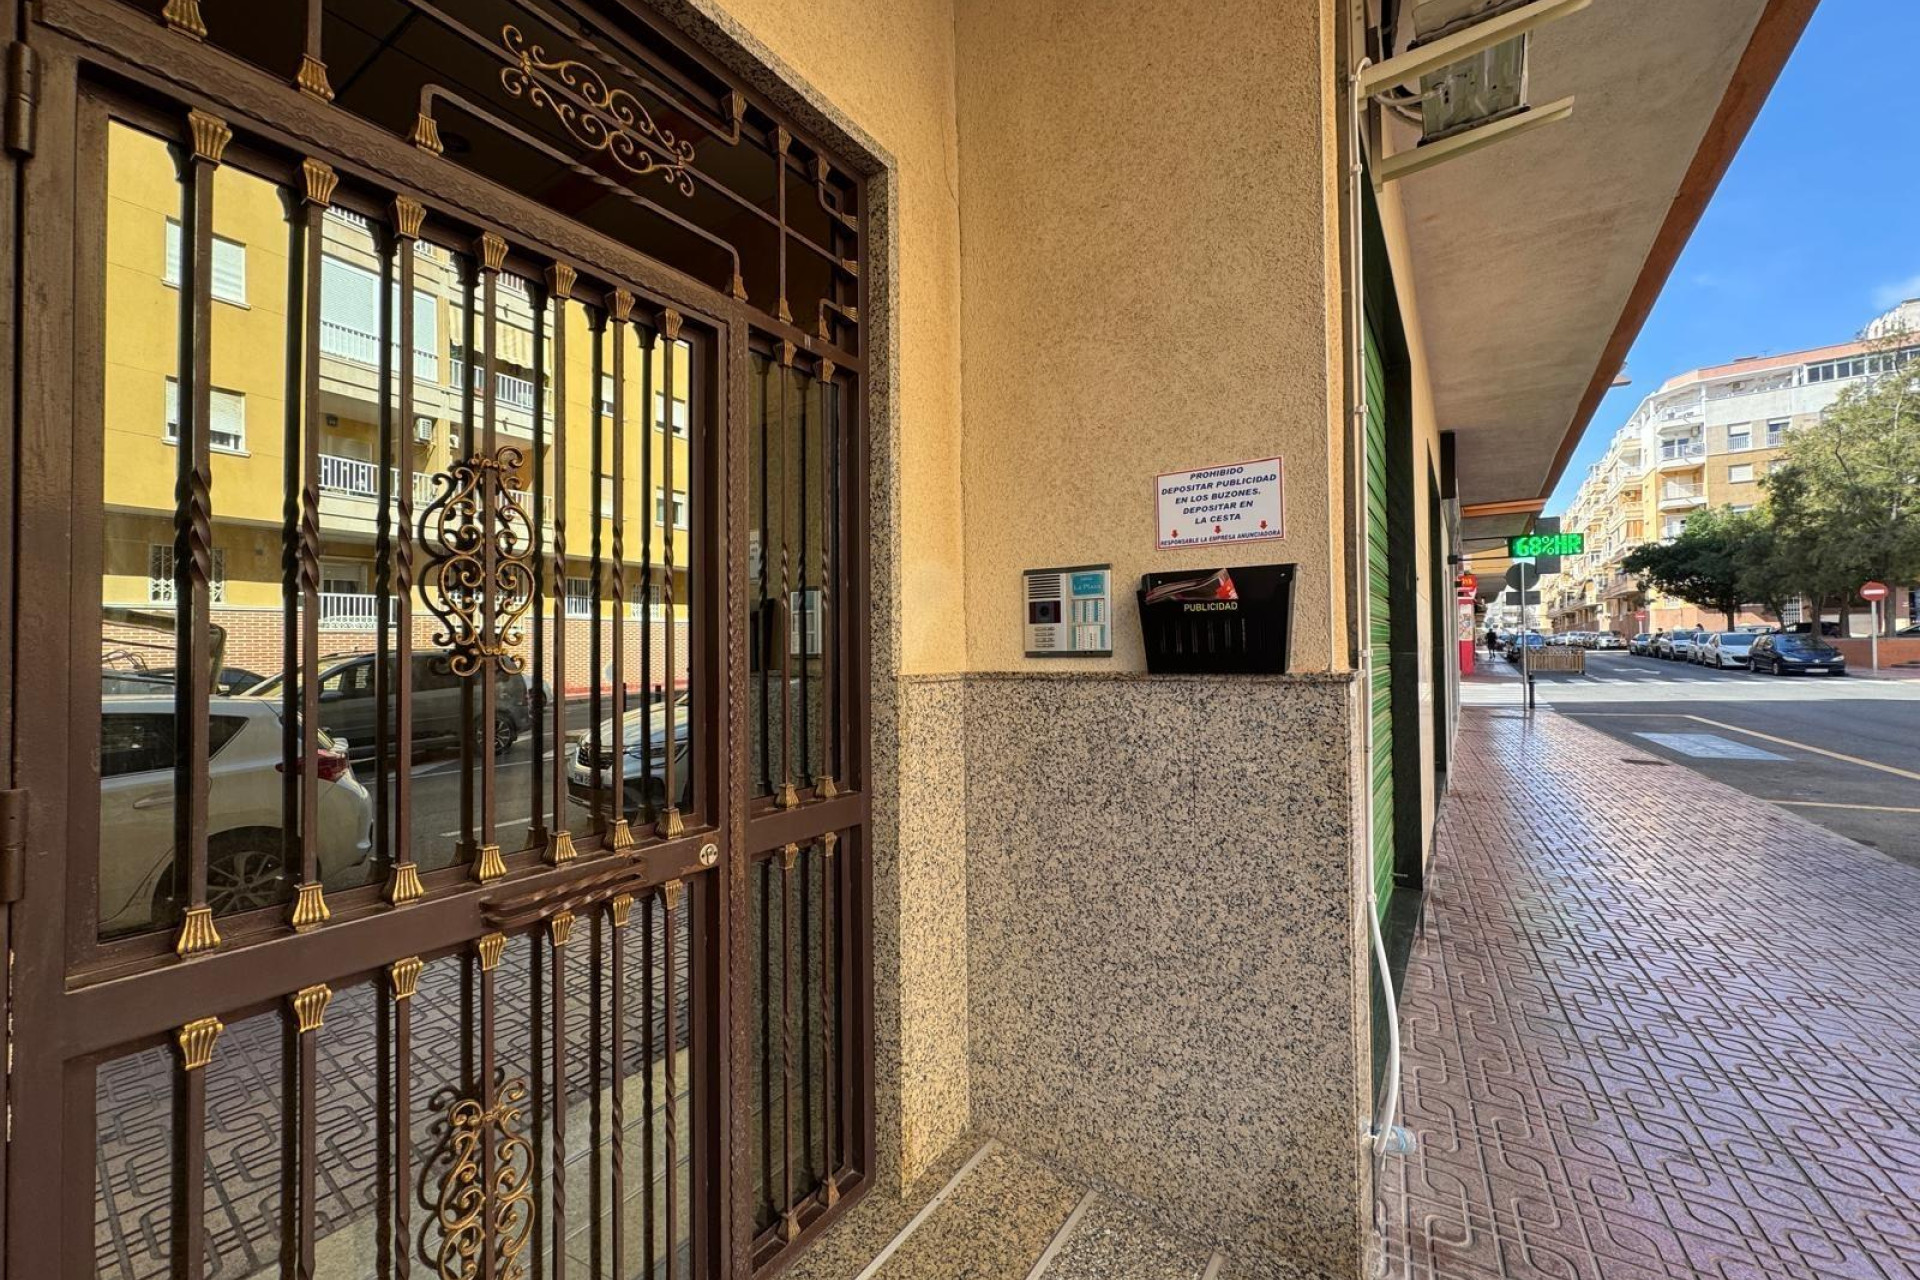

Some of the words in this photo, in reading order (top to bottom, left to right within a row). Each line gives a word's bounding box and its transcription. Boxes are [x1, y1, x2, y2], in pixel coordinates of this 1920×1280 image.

[1190, 466, 1244, 480] PROHIBIDO
[1161, 482, 1214, 496] DEPOSITAR
[1216, 474, 1277, 488] PUBLICIDAD
[1175, 496, 1189, 505] EN
[1190, 494, 1209, 503] LOS
[1211, 488, 1261, 501] BUZONES.
[1183, 501, 1237, 515] DEPOSITAR
[1239, 500, 1254, 509] EN
[1195, 516, 1207, 525] LA
[1210, 513, 1241, 523] CESTA
[1160, 537, 1199, 546] RESPONSABLE
[1209, 533, 1236, 542] EMPRESA
[1237, 529, 1281, 539] ANUNCIADORA
[1516, 534, 1582, 556] 68%HR
[1183, 602, 1238, 612] PUBLICIDAD
